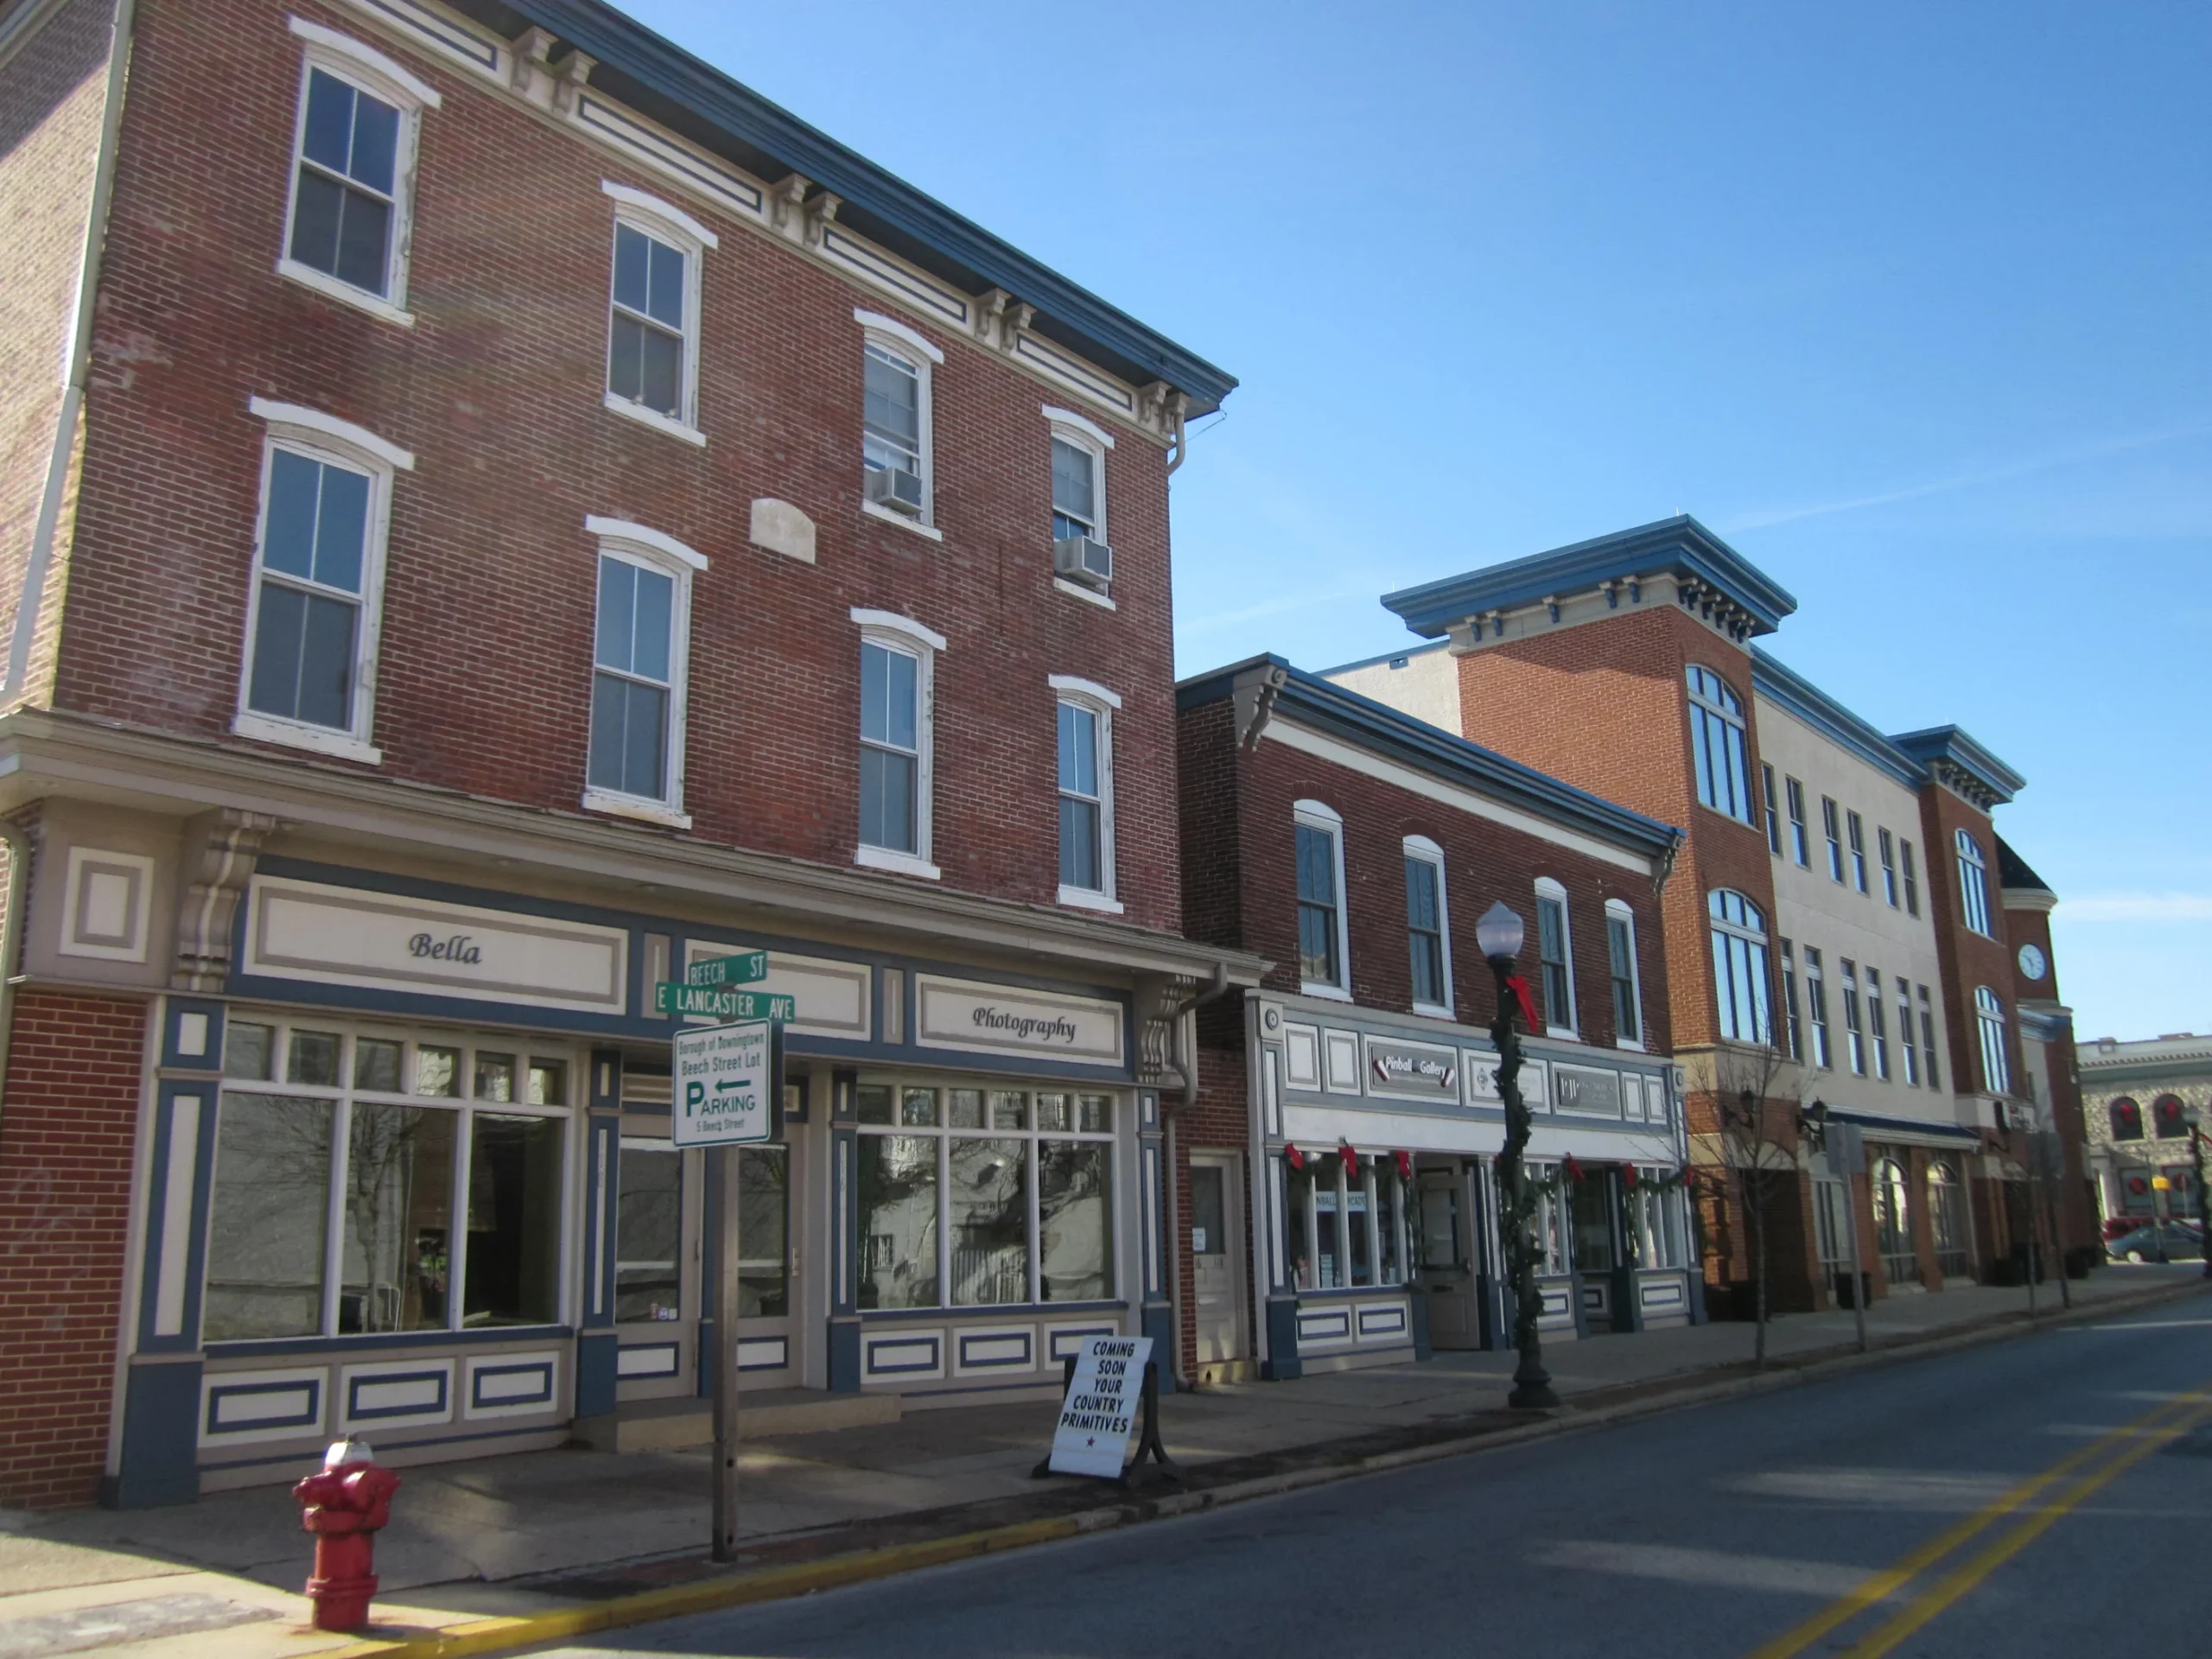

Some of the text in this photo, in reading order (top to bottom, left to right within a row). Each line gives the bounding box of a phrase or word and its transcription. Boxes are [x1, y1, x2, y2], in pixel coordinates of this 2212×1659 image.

[409, 932, 483, 964] Bella
[690, 954, 765, 987] BEECH ST
[658, 986, 792, 1020] E LANCASTER AVE
[972, 1006, 1077, 1044] Photography
[678, 1033, 765, 1056] Borough of Downingtown
[682, 1052, 761, 1076] Beech Street Lot
[1385, 1055, 1413, 1072] Pinball
[1420, 1060, 1446, 1079] Gallery
[686, 1081, 756, 1118] PARKING
[702, 1120, 722, 1132] Beech
[724, 1118, 745, 1130] Street
[1093, 1341, 1135, 1357] COMING
[1097, 1359, 1127, 1376] SOON
[1094, 1378, 1122, 1394] YOUR
[1073, 1395, 1124, 1414] COUNTRY
[1060, 1412, 1128, 1433] PRIMITIVES
